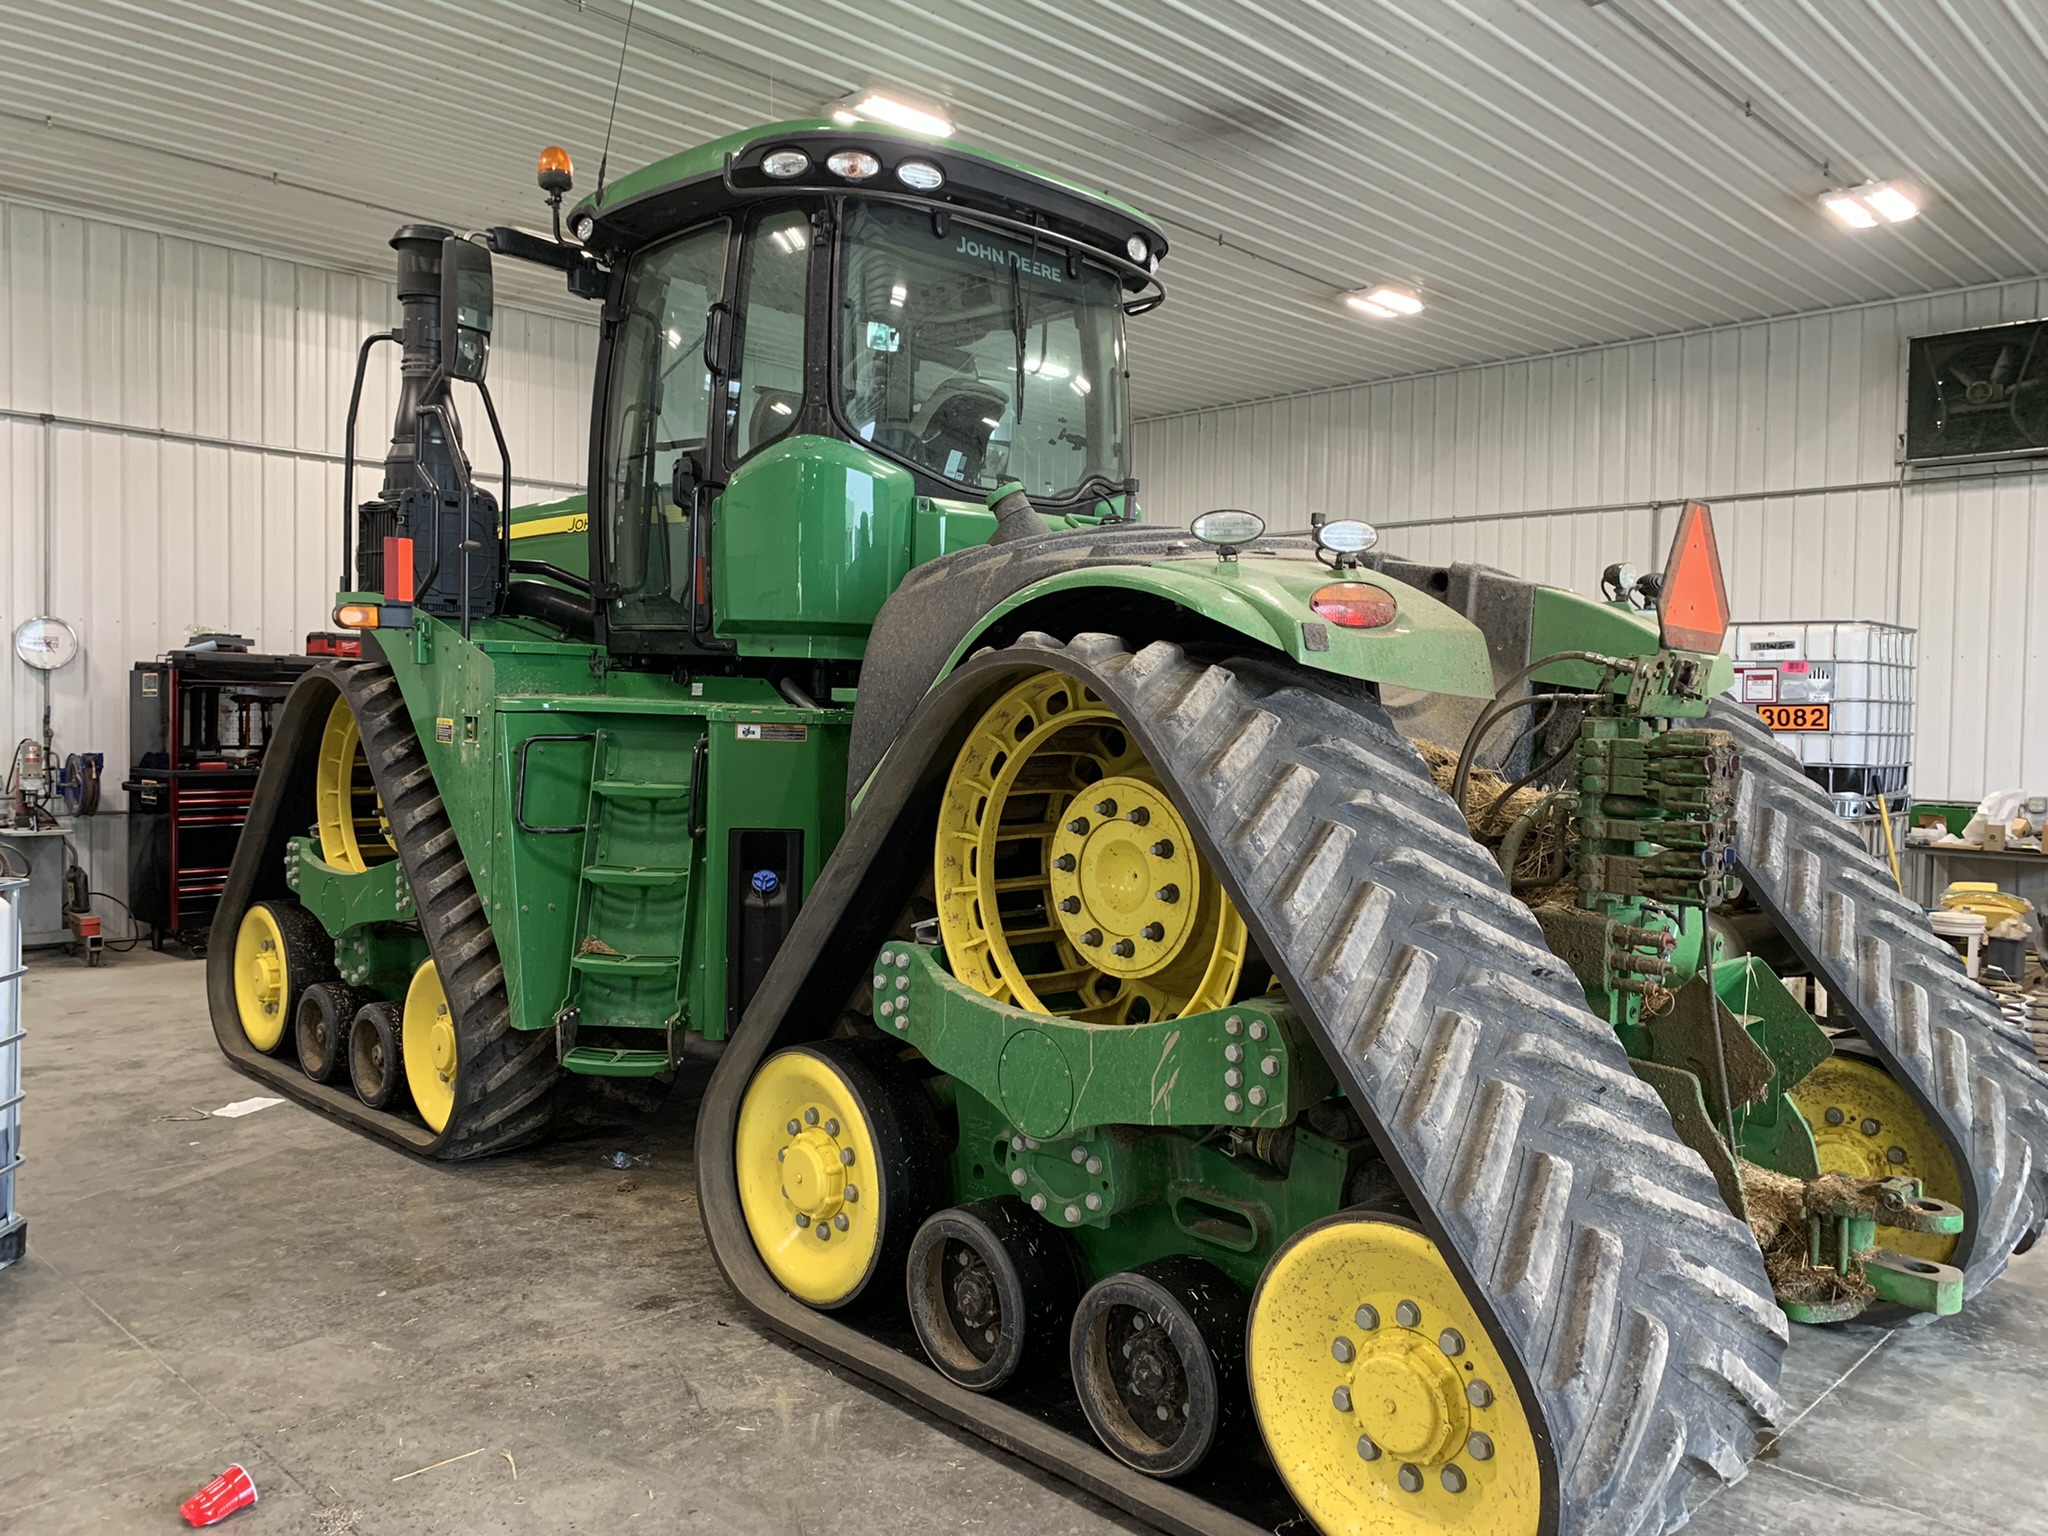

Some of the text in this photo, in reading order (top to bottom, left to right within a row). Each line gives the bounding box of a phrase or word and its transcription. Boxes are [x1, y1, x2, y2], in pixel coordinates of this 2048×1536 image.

[956, 236, 1062, 283] JOHN DEERE
[1762, 708, 1824, 726] 3082
